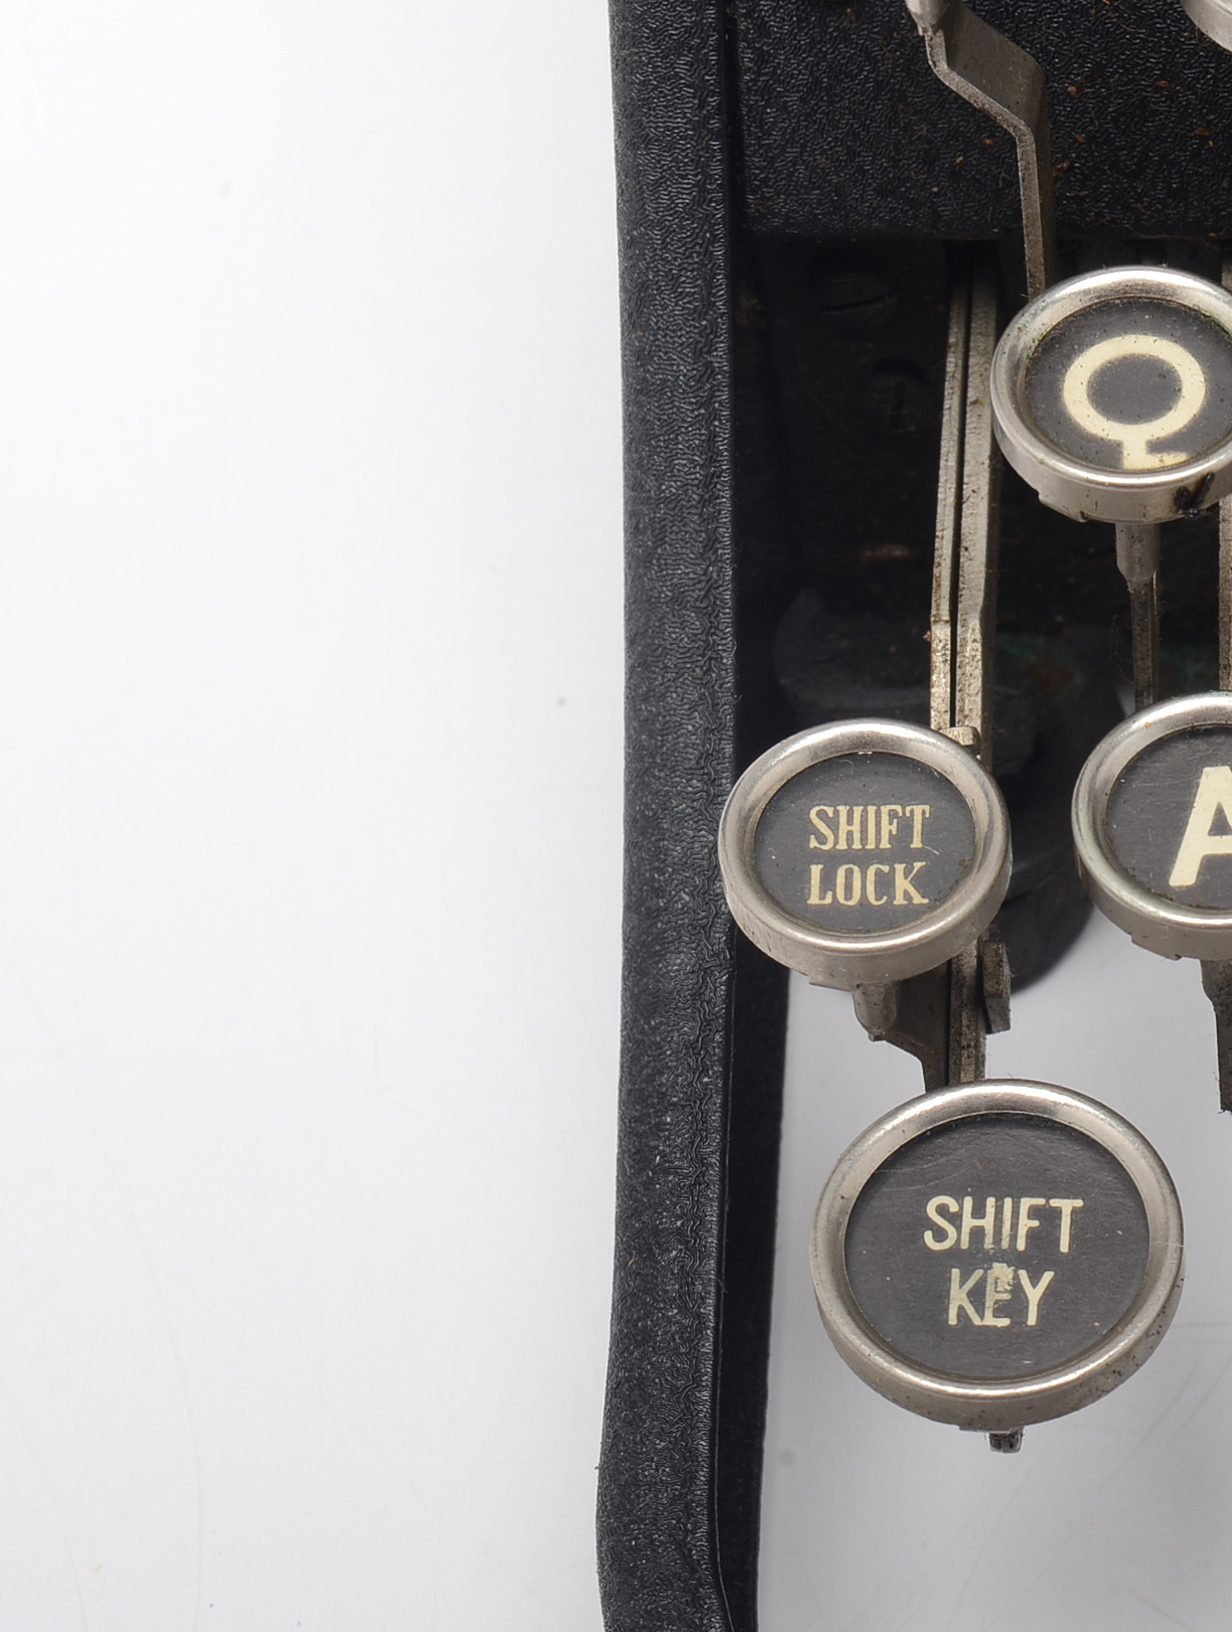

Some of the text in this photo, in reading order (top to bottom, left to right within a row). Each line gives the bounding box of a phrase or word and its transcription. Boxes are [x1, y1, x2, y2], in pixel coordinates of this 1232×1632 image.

[1062, 333, 1206, 470] Q
[808, 805, 931, 851] SHIFT
[807, 862, 930, 908] LOCK
[923, 1196, 1083, 1254] SHIFT
[947, 1266, 1054, 1328] KEY
